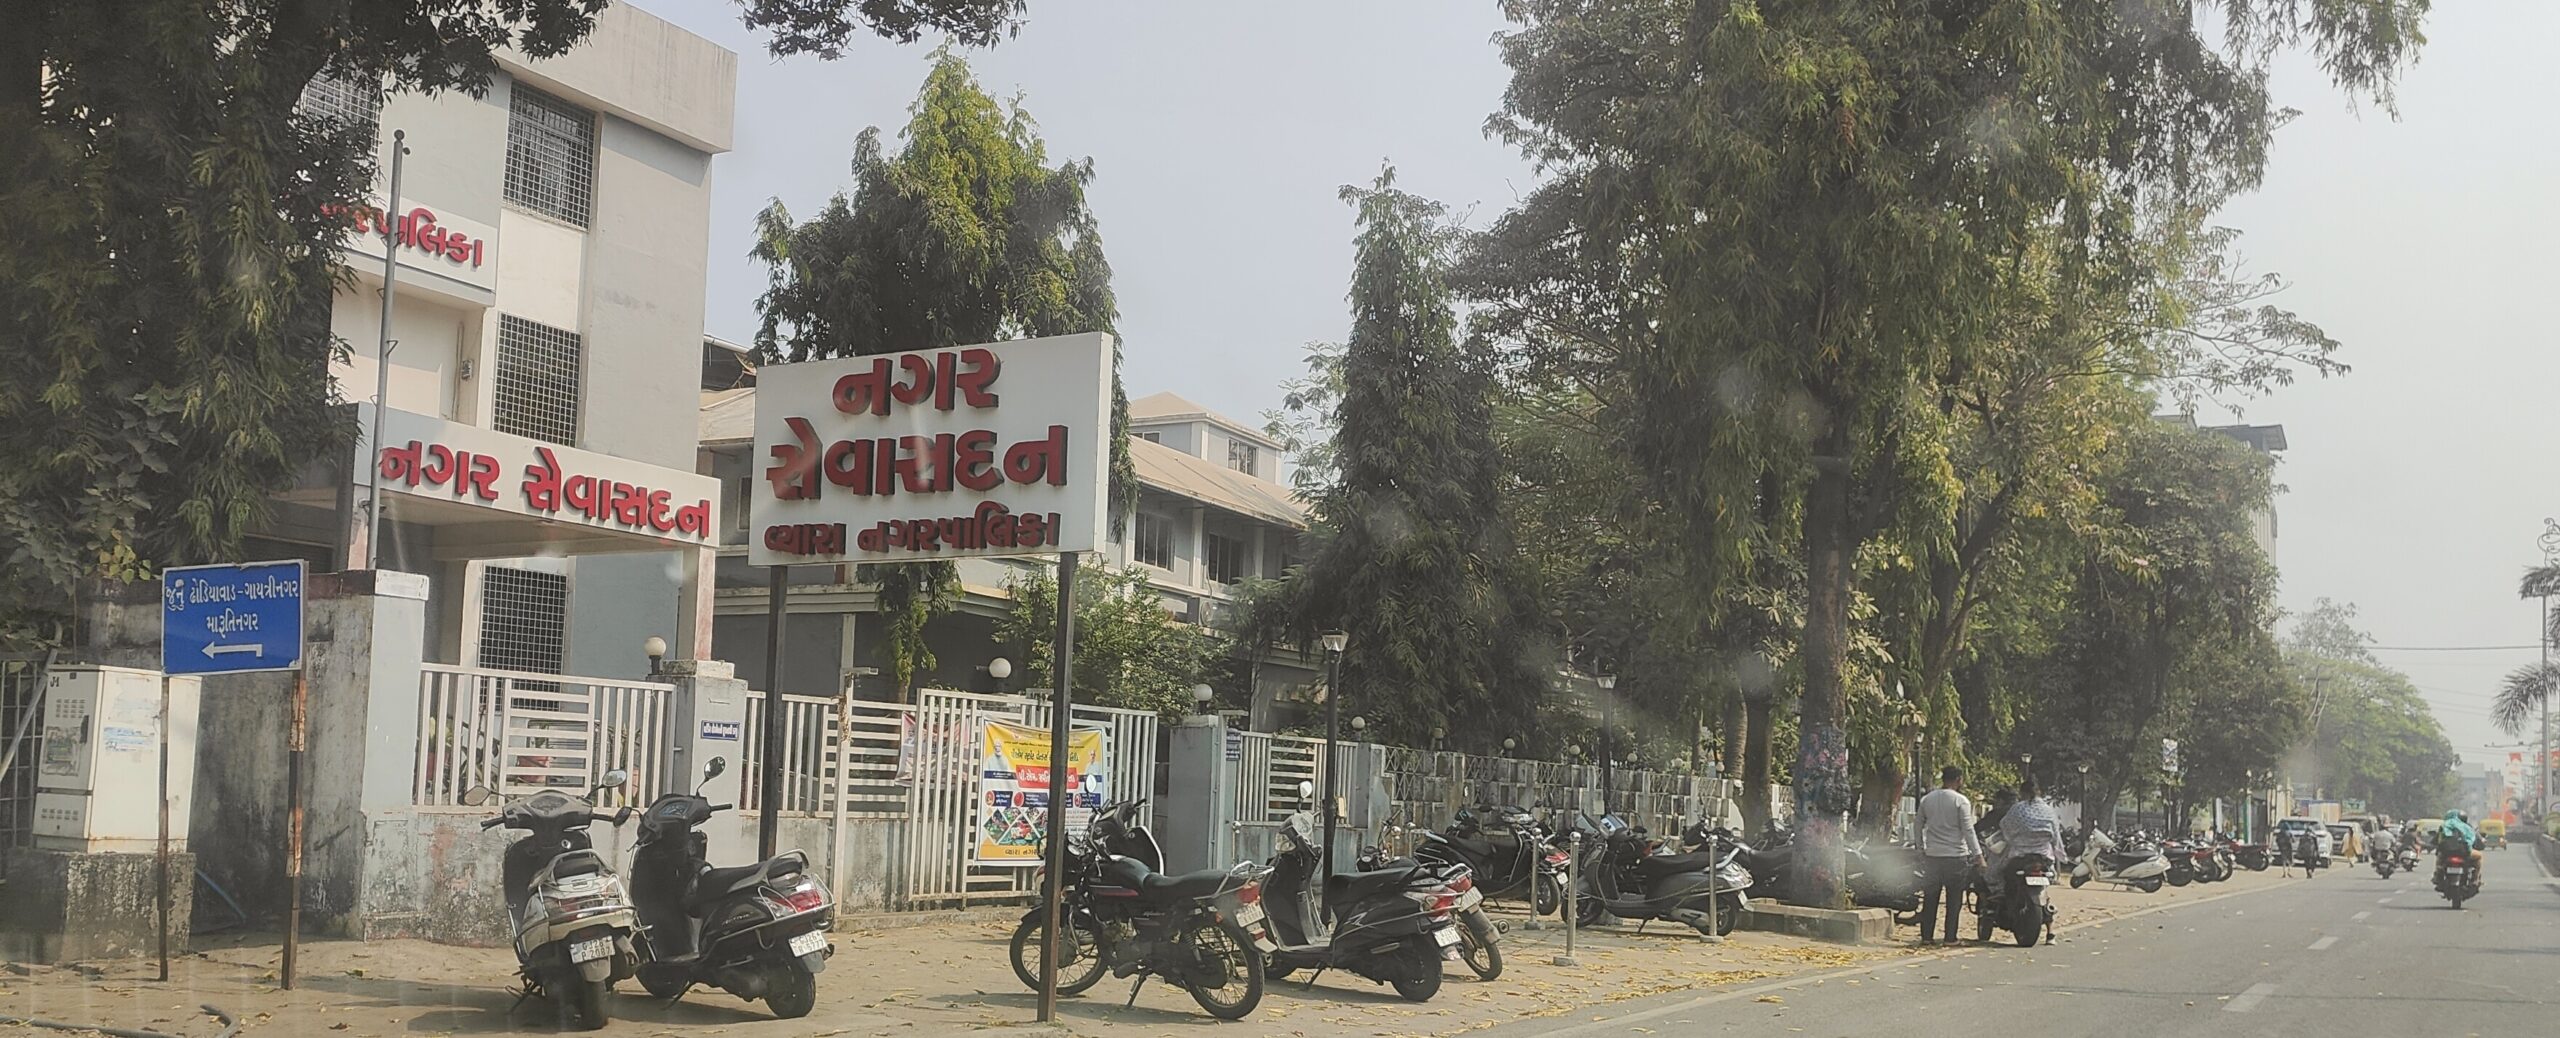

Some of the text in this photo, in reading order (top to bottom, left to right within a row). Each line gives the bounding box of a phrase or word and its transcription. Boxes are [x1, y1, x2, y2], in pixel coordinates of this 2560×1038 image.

[832, 348, 1003, 416] નગર
[380, 439, 711, 539] નગર સેવાસદન
[766, 417, 1069, 501] સેવાસદન
[764, 501, 1061, 555] વ્યારા નગરપાલિકા
[206, 608, 259, 639] મારૂતિનગર
